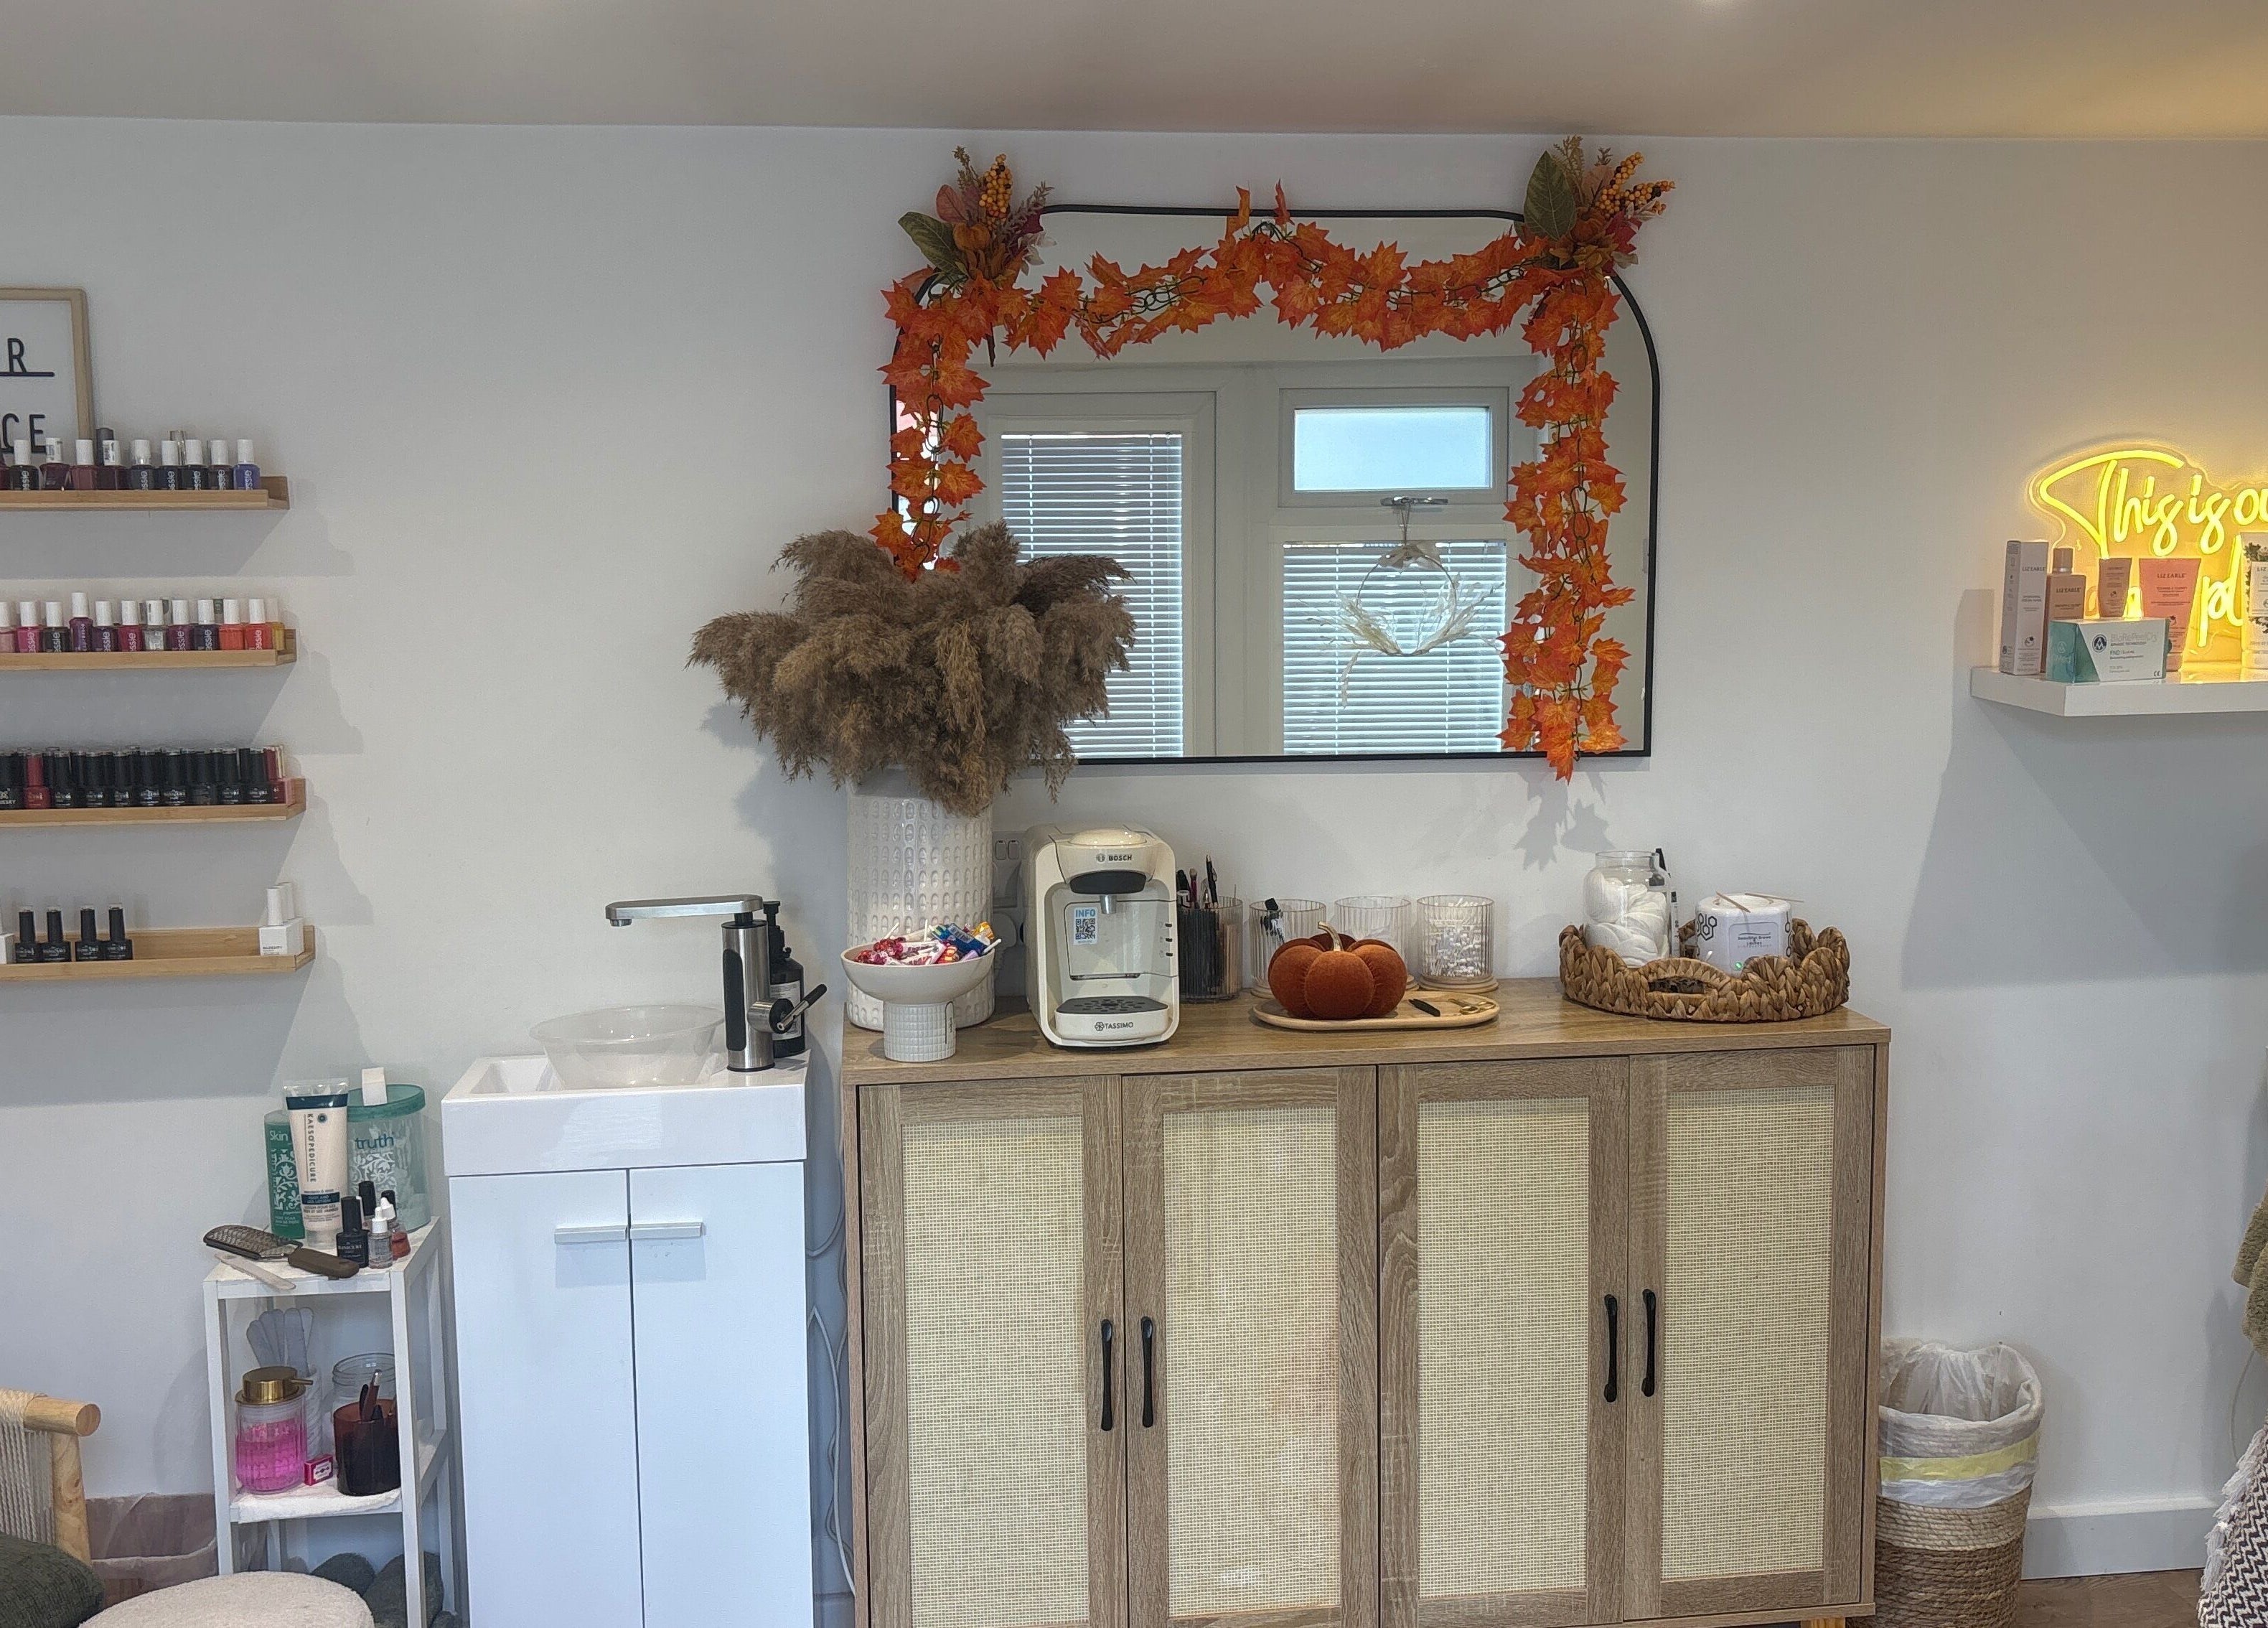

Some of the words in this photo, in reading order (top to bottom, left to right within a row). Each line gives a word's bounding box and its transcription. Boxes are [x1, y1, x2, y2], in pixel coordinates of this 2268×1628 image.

[2039, 450, 2185, 561] This
[2188, 474, 2231, 555] is
[1075, 909, 1096, 917] INFO
[269, 1131, 289, 1141] Skin
[355, 1133, 394, 1149] truth
